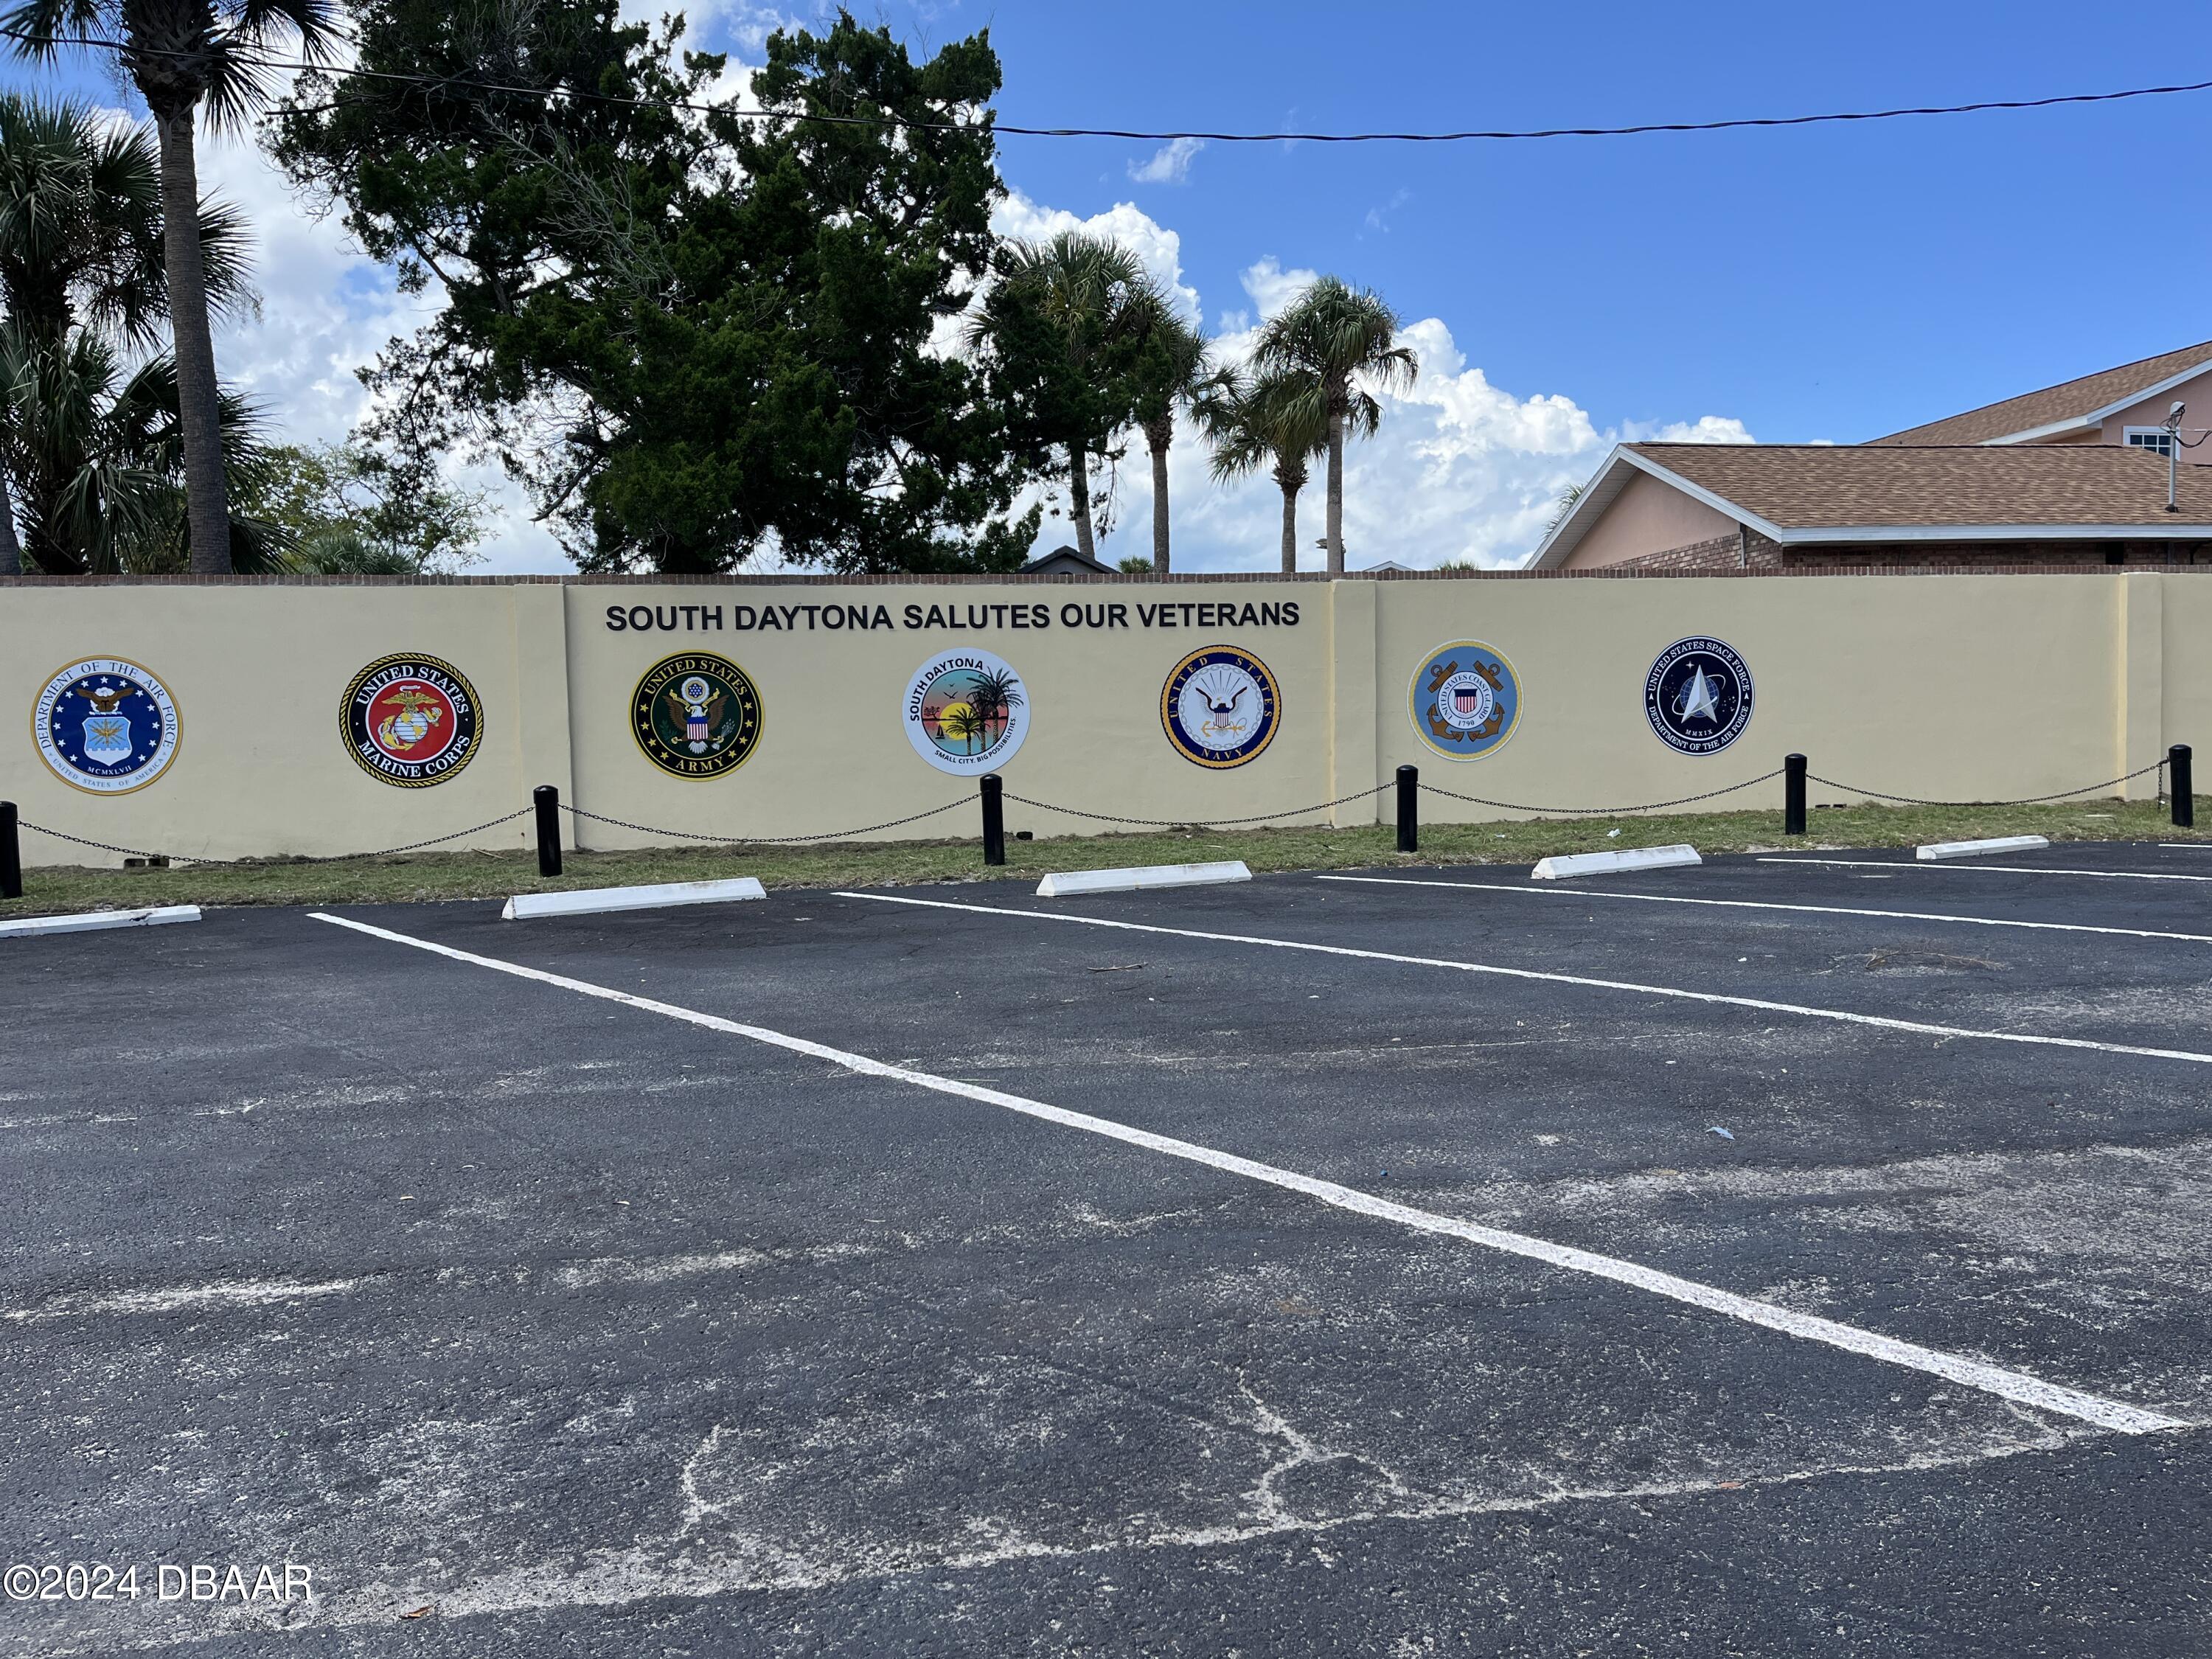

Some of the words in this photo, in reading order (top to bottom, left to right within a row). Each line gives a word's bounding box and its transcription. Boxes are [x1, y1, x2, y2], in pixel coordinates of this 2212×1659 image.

[606, 605, 723, 630] SOUTH
[735, 605, 894, 630] DAYTONA
[903, 604, 1051, 629] SALUTES
[1060, 603, 1128, 627] OUR
[1136, 602, 1299, 627] VETERANS
[644, 659, 695, 695] UNITED
[700, 660, 748, 695] STATES
[1648, 655, 1671, 691] UNITED
[1670, 641, 1705, 658] STATES
[1706, 642, 1733, 661] SPACE
[1732, 659, 1750, 692] FORCE
[356, 666, 414, 705] UNITED
[418, 667, 470, 714] STATES
[911, 681, 928, 721] SOUTH
[925, 658, 983, 681] DAYTONA
[1169, 657, 1208, 718] UNITED
[1236, 658, 1273, 717] STATES
[1444, 675, 1467, 689] STATES
[1469, 675, 1489, 692] COAST
[37, 670, 73, 749] DEPARTMENT
[81, 661, 100, 673] OF
[109, 662, 139, 678] THE
[143, 679, 165, 700] AIR
[162, 706, 175, 749] FORCE
[1440, 692, 1453, 720] UNITED
[1479, 693, 1491, 720] GUARD
[1649, 706, 1688, 749] DEPARTMENT
[1702, 740, 1719, 750] THE
[1721, 731, 1734, 744] AIR
[1732, 706, 1748, 732] FORCE
[1686, 728, 1713, 737] MMXIX
[358, 740, 421, 777] MARINE
[425, 735, 470, 775] CORPS
[675, 757, 724, 771] ARMY
[935, 750, 956, 763] SMALL
[977, 754, 989, 762] BIG
[1201, 748, 1243, 760] NAVY
[52, 758, 77, 779] UNITED
[83, 778, 111, 787] STATES
[135, 757, 164, 782] AMERICA
[87, 765, 132, 775] MCMXLVII
